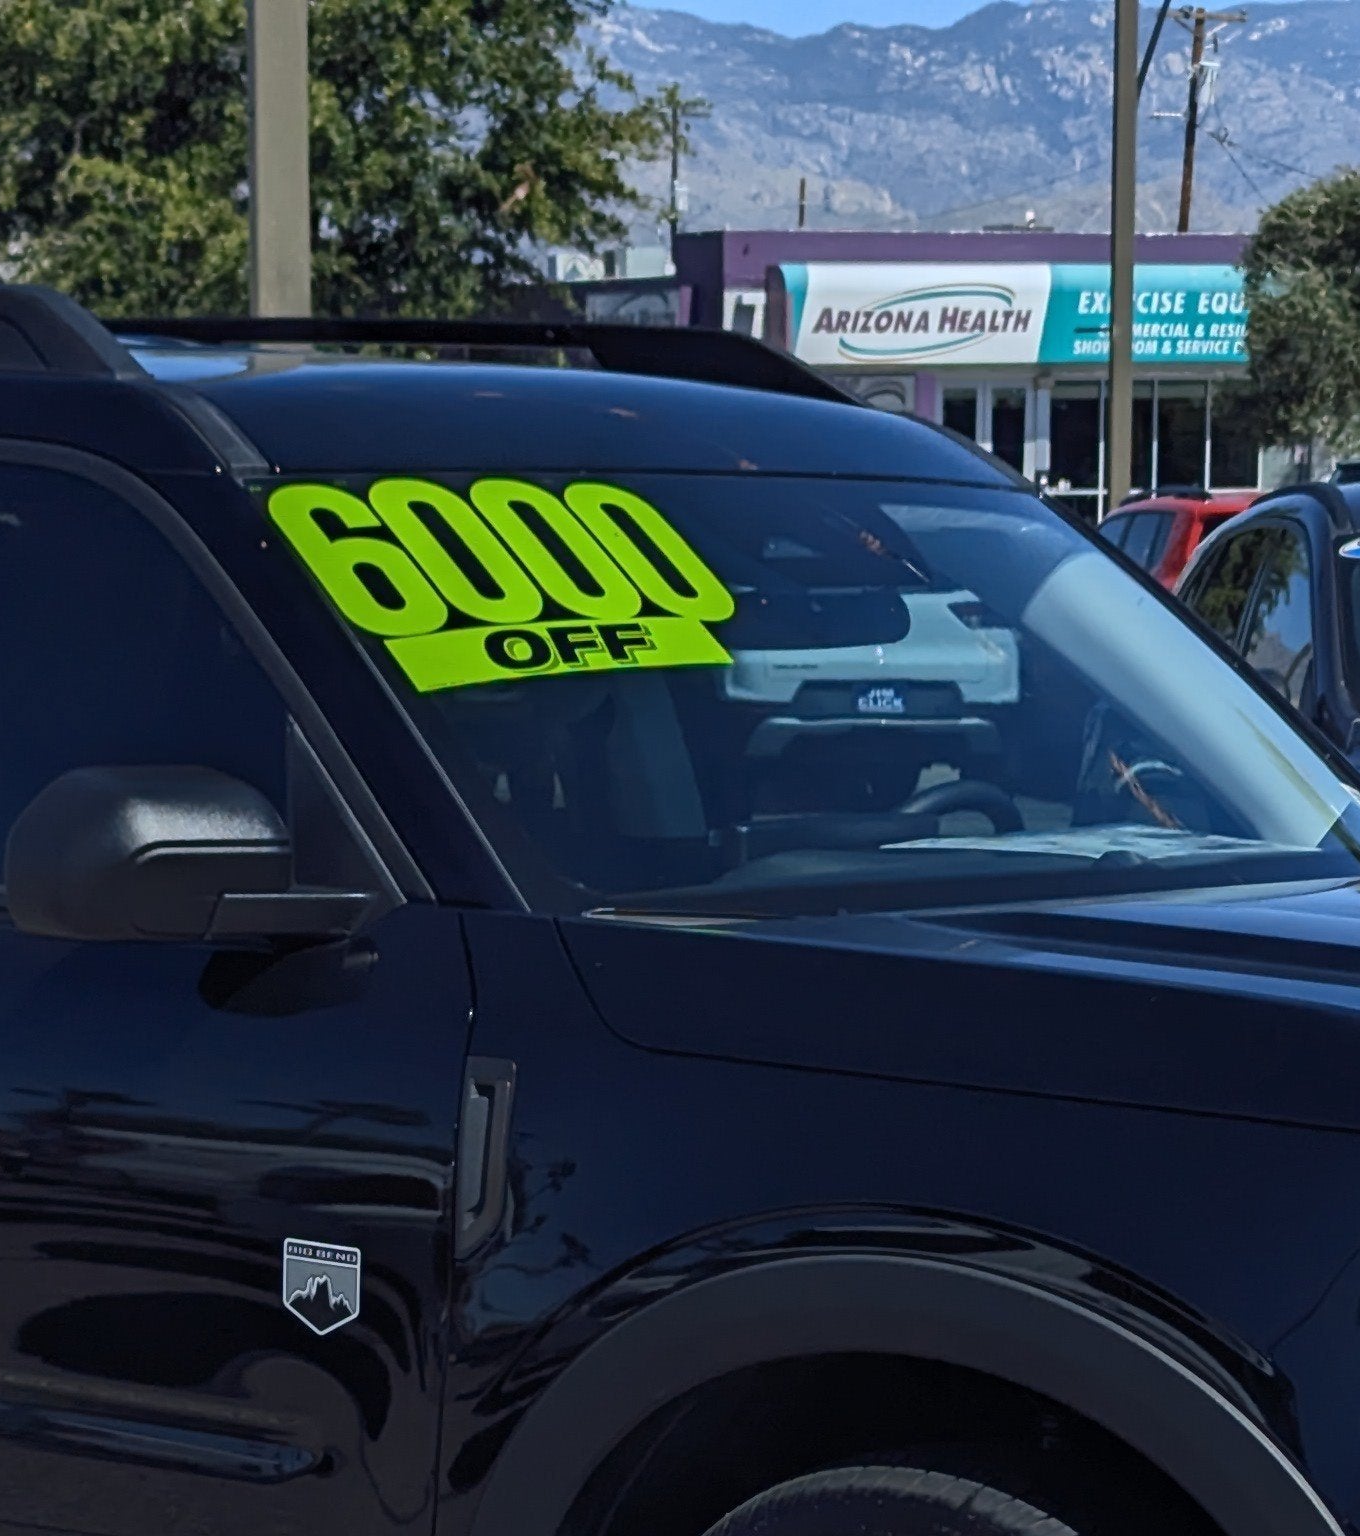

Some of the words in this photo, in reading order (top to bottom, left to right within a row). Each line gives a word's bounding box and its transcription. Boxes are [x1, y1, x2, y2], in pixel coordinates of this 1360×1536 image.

[812, 307, 929, 334] ARIZONA
[937, 306, 1033, 333] HEALTH
[1194, 324, 1205, 337] &
[1161, 340, 1172, 354] &
[1176, 341, 1230, 354] SERVICE
[267, 478, 736, 638] 6000
[483, 622, 658, 673] OFF
